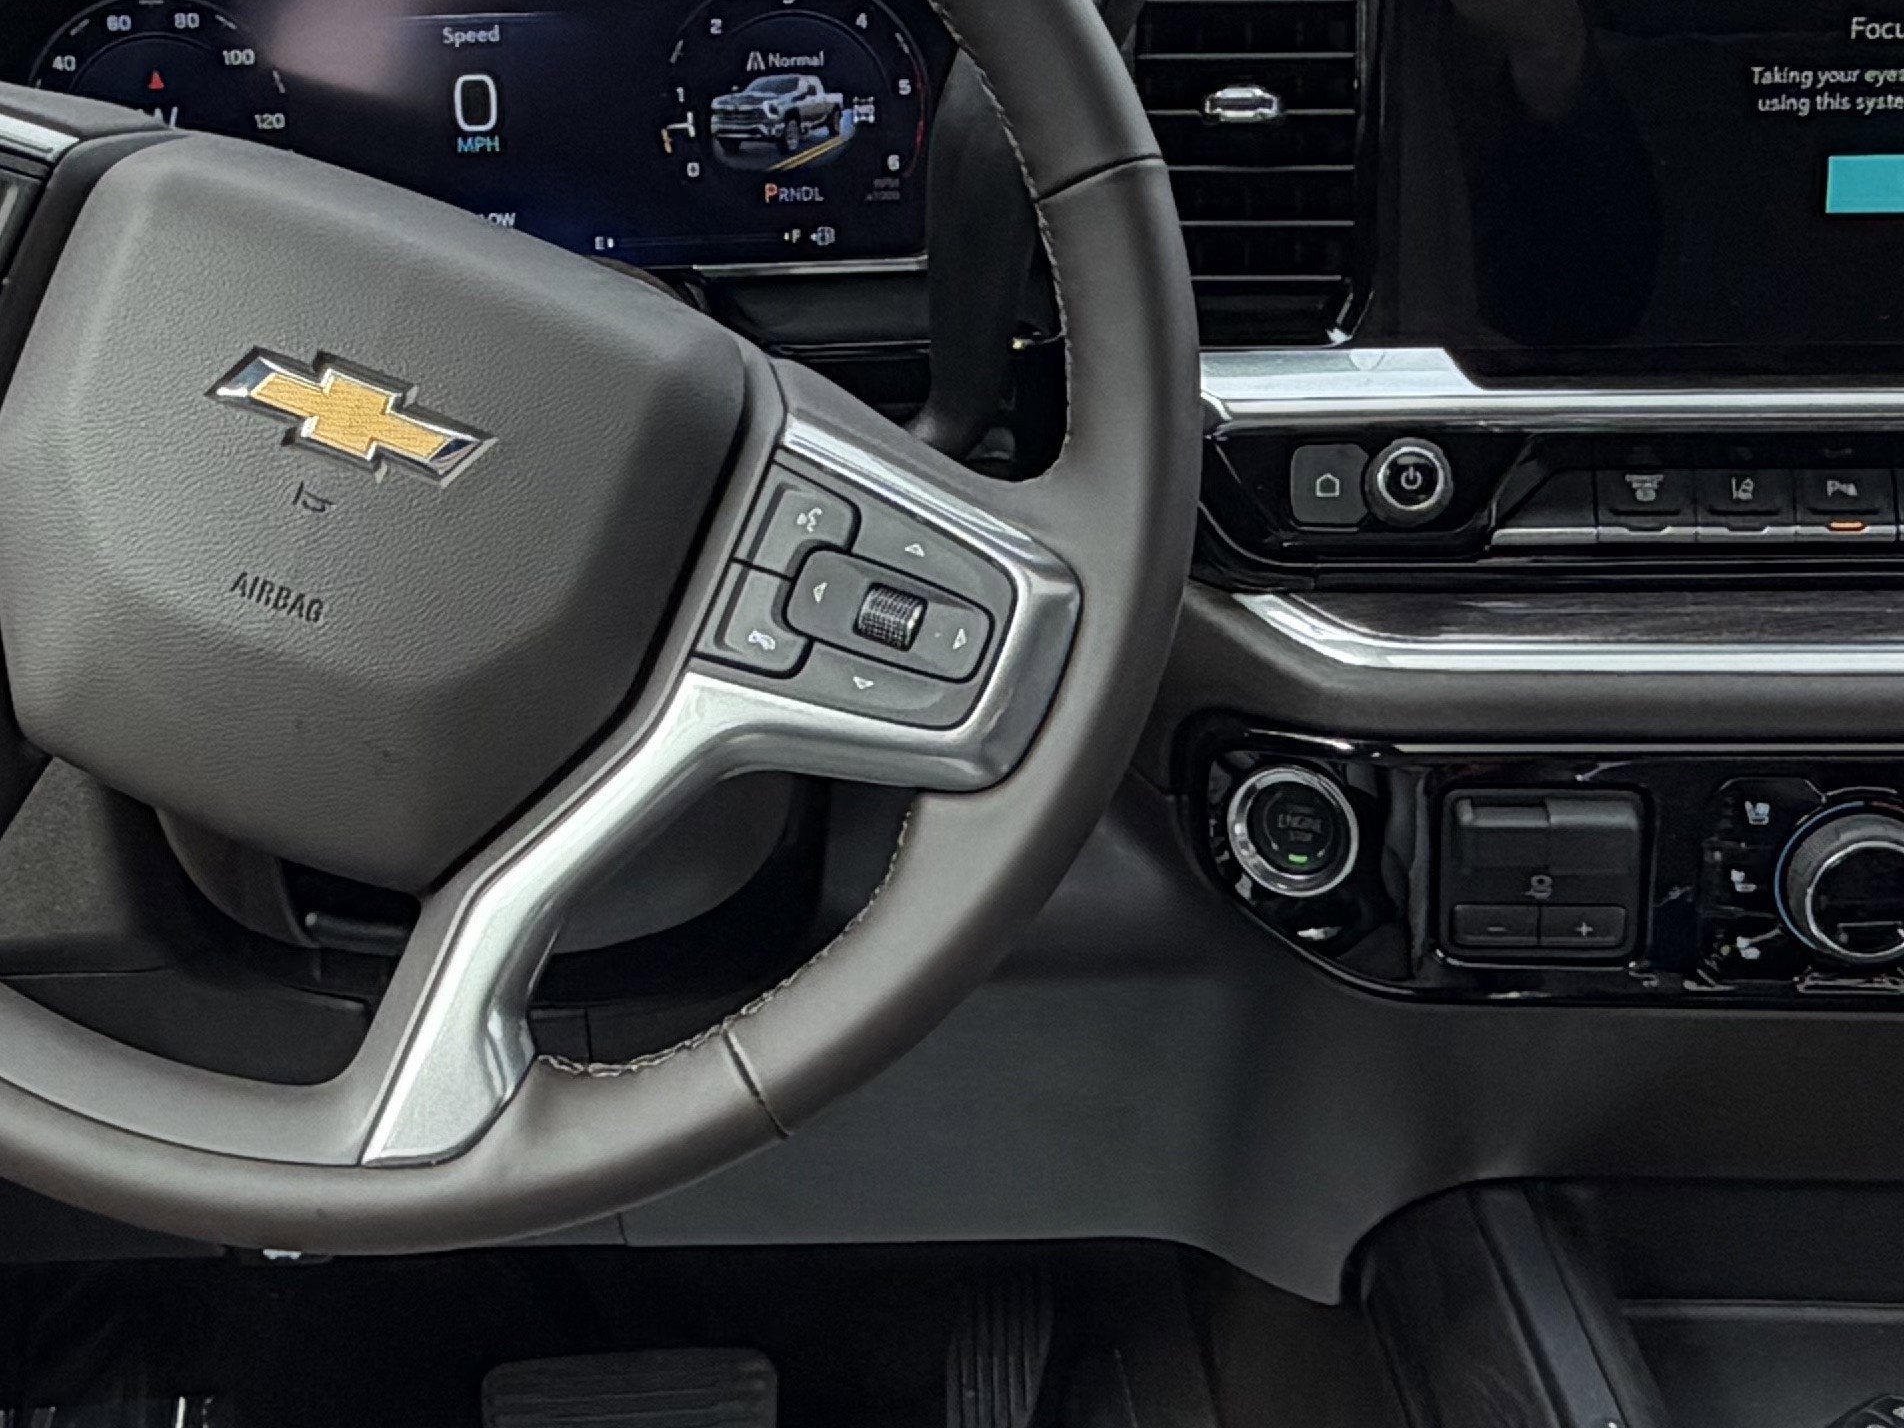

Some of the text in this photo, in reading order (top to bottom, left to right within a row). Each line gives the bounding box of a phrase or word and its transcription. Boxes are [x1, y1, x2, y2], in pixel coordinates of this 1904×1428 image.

[107, 15, 132, 31] 60
[174, 12, 200, 29] 80
[710, 18, 722, 34] 2
[856, 12, 868, 29] 4
[442, 24, 500, 48] Speed
[52, 55, 76, 72] 40
[223, 49, 255, 66] 100
[768, 50, 824, 68] Normal
[1751, 66, 1813, 89] Taking
[1816, 69, 1860, 88] your
[676, 87, 685, 103] 1
[898, 79, 911, 95] 5
[454, 74, 498, 132] 0
[1758, 93, 1810, 117] using
[1816, 91, 1851, 110] this
[254, 113, 286, 130] 120
[457, 135, 500, 154] MPH
[686, 162, 699, 178] 0
[887, 154, 900, 171] 6
[765, 183, 823, 204] PRNDL
[229, 571, 324, 623] AIRBAG
